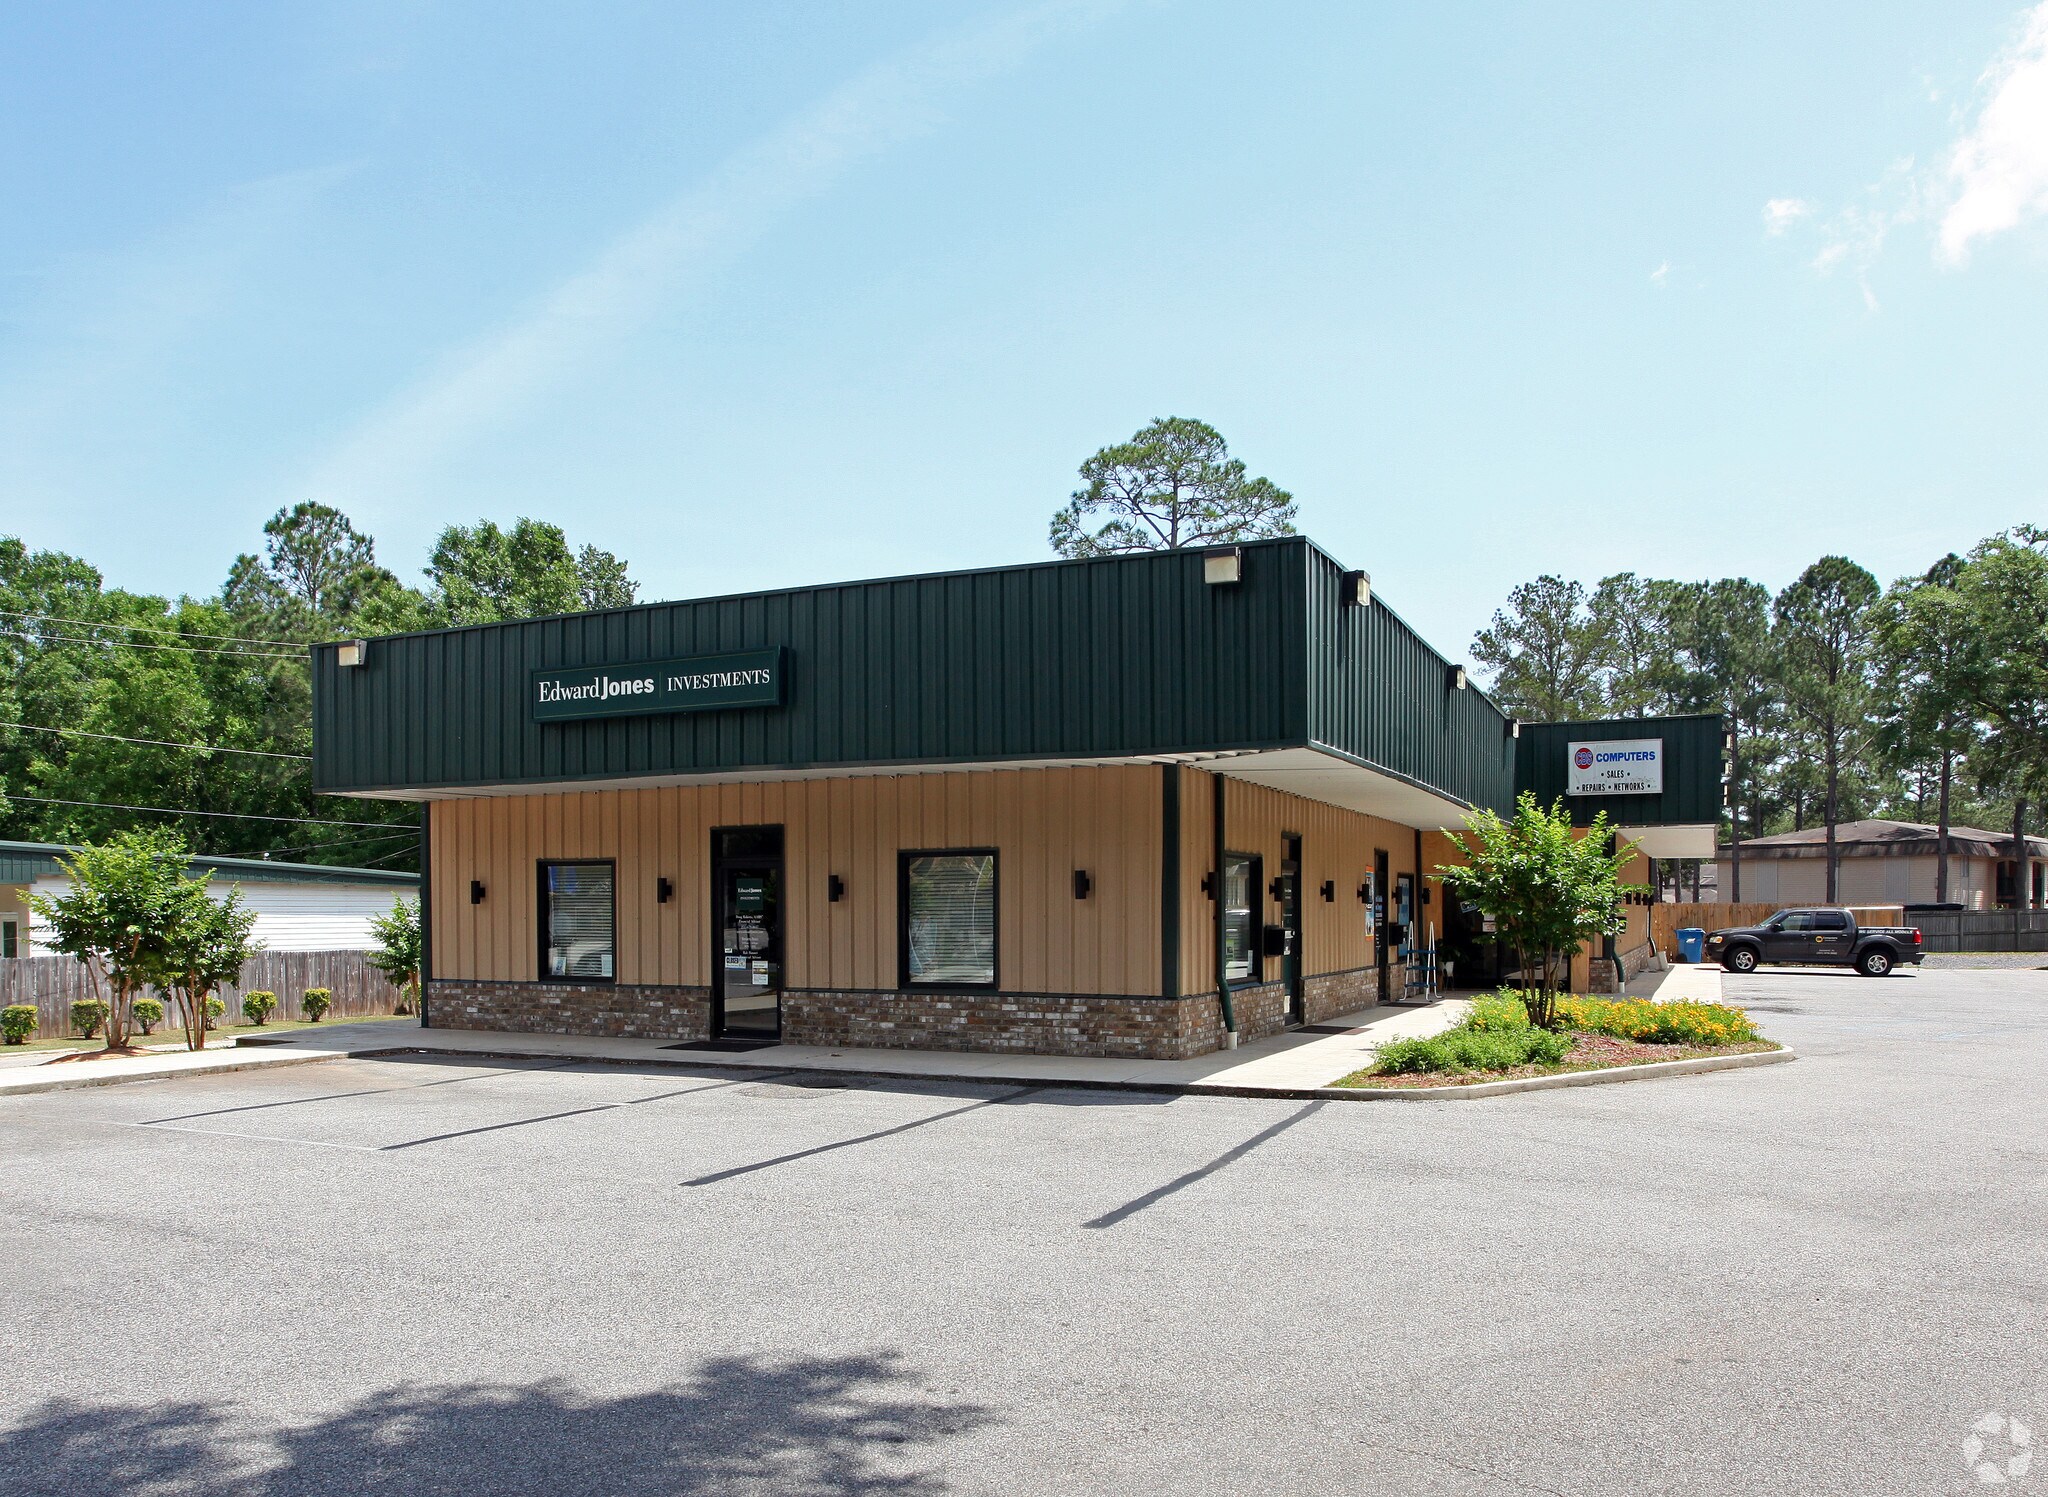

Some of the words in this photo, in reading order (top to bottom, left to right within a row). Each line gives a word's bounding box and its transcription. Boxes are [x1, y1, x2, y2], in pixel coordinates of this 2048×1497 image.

[667, 669, 770, 692] INVESTMENTS
[1596, 751, 1656, 762] COMPUTERS
[1606, 770, 1625, 779] SALES
[1582, 783, 1606, 792] REPAIRS
[1613, 782, 1645, 791] NETWORKS
